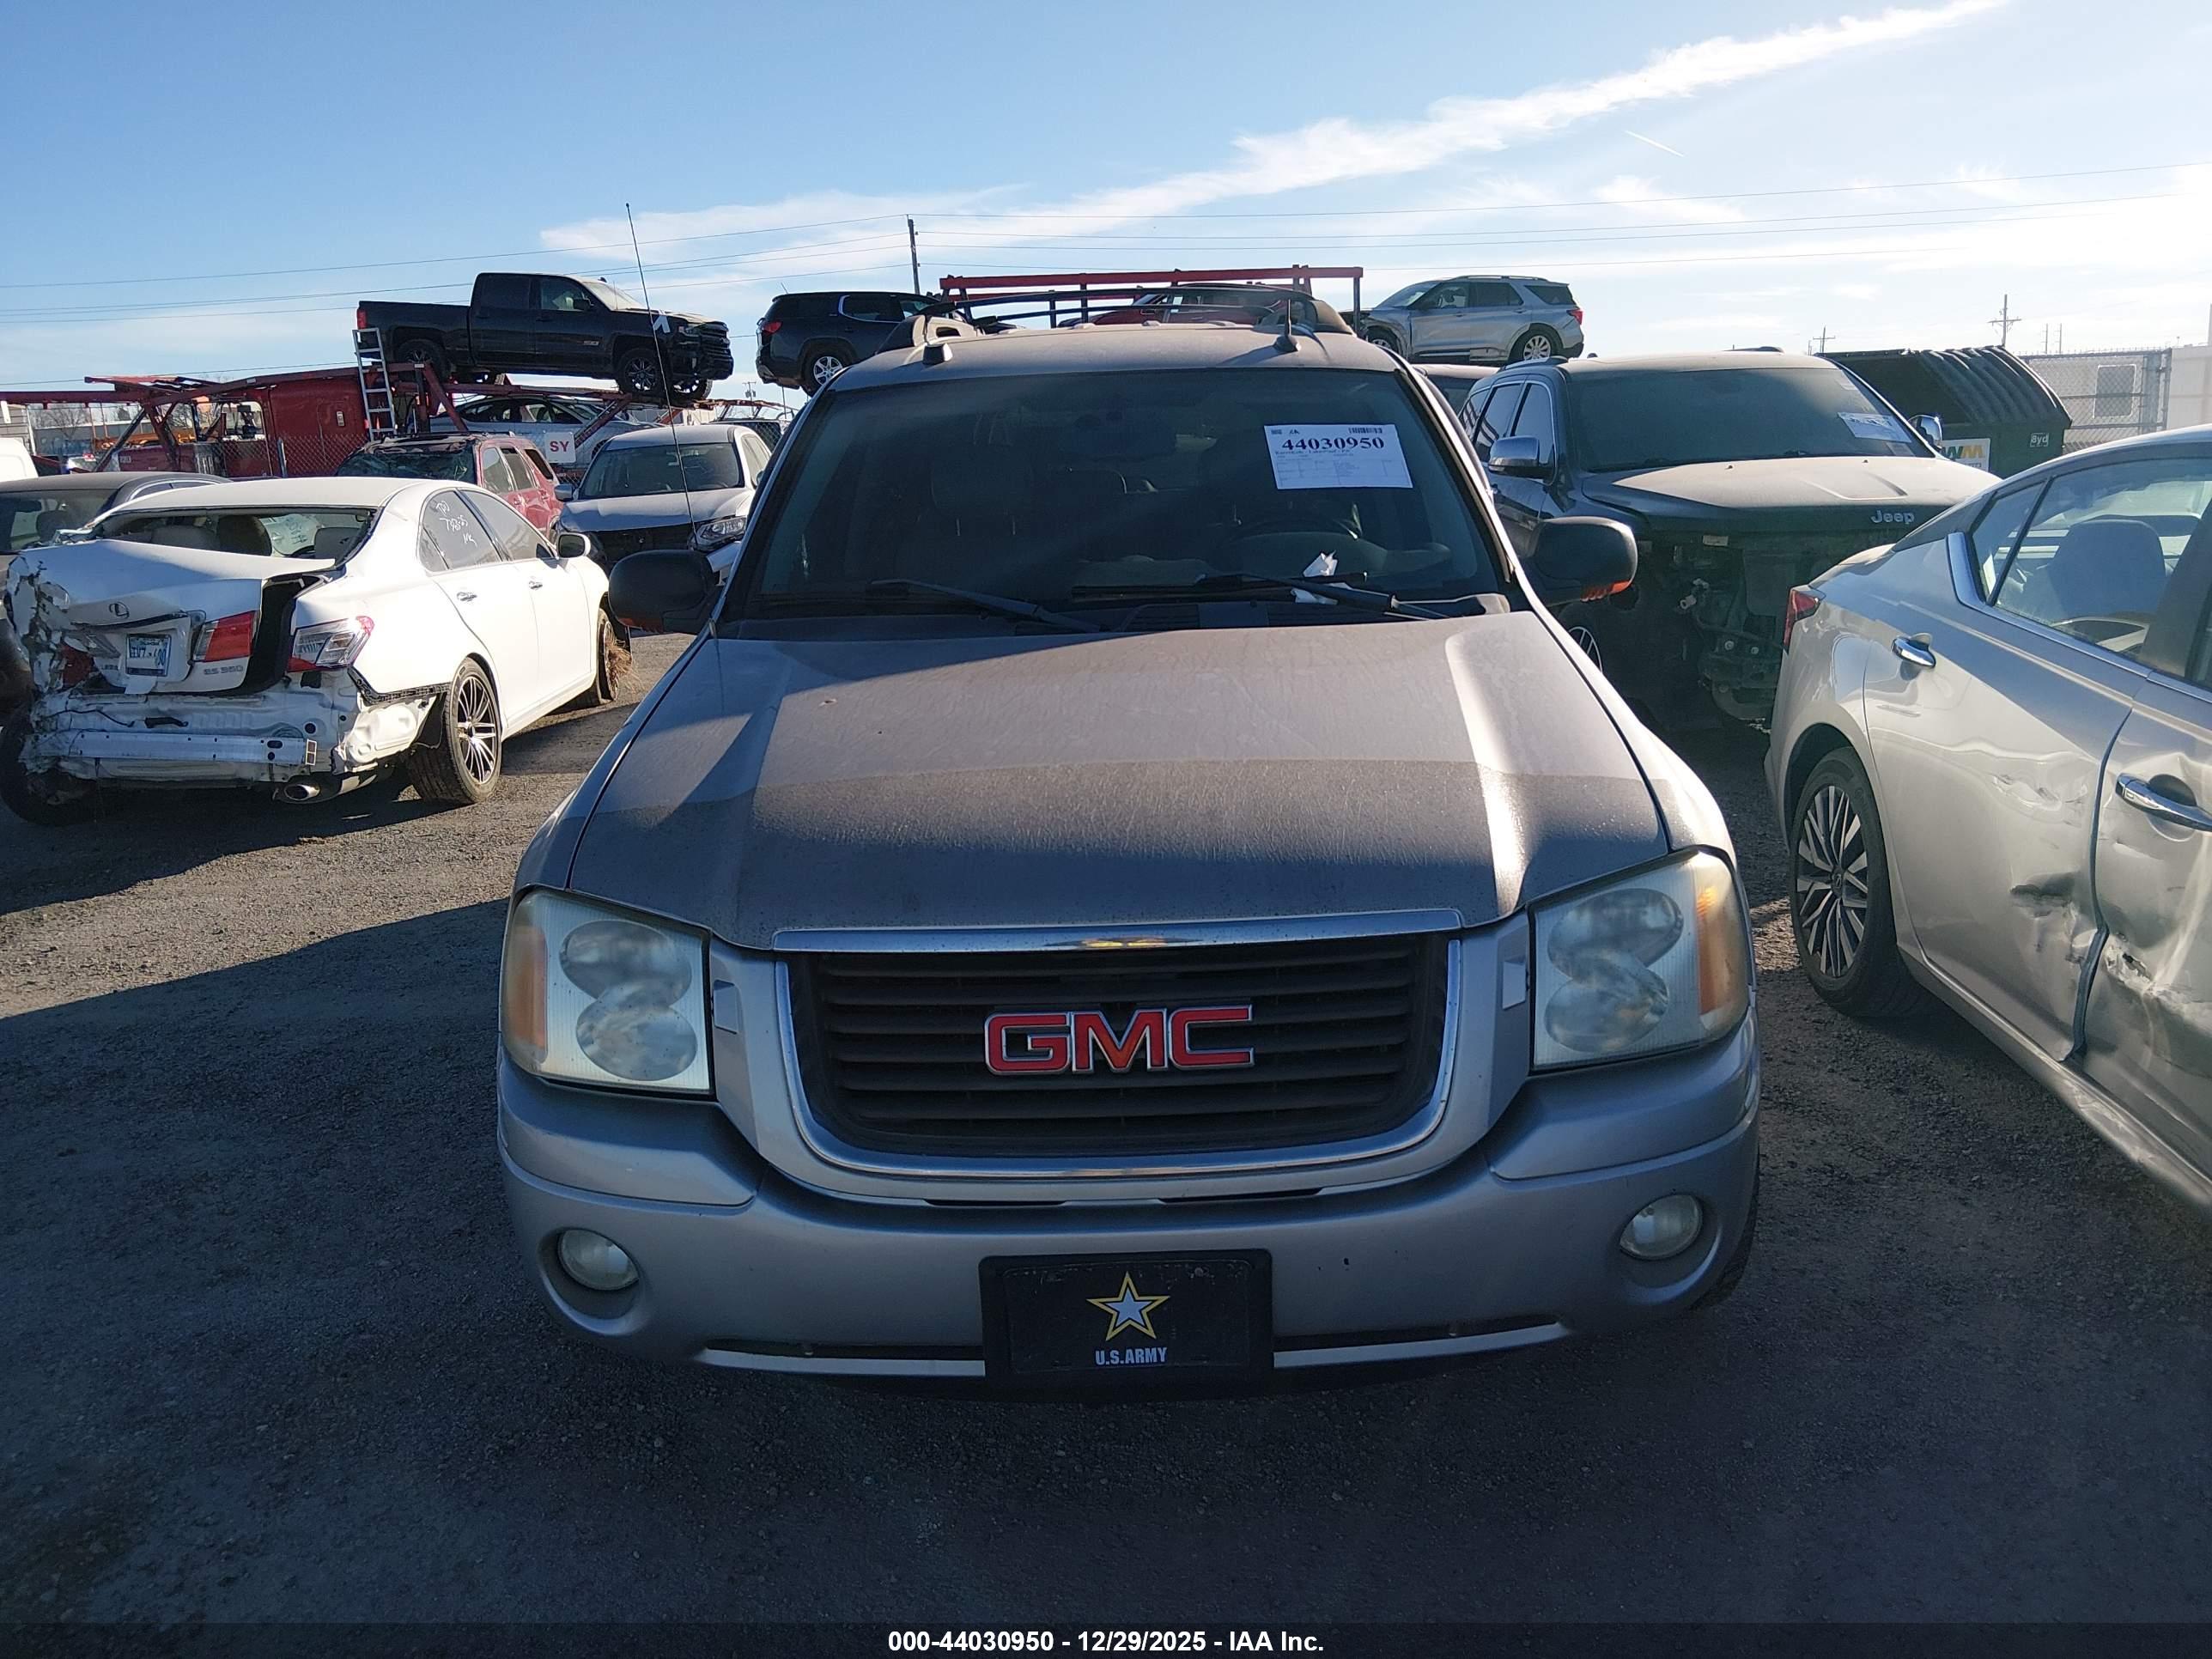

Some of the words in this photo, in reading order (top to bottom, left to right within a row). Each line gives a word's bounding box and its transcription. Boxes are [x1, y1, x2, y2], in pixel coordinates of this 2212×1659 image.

[550, 441, 570, 453] SY
[1282, 436, 1385, 451] 44030950
[1870, 509, 1915, 525] Jeep
[984, 1004, 1255, 1075] GMC
[1095, 1346, 1168, 1365] U.S.ARMY
